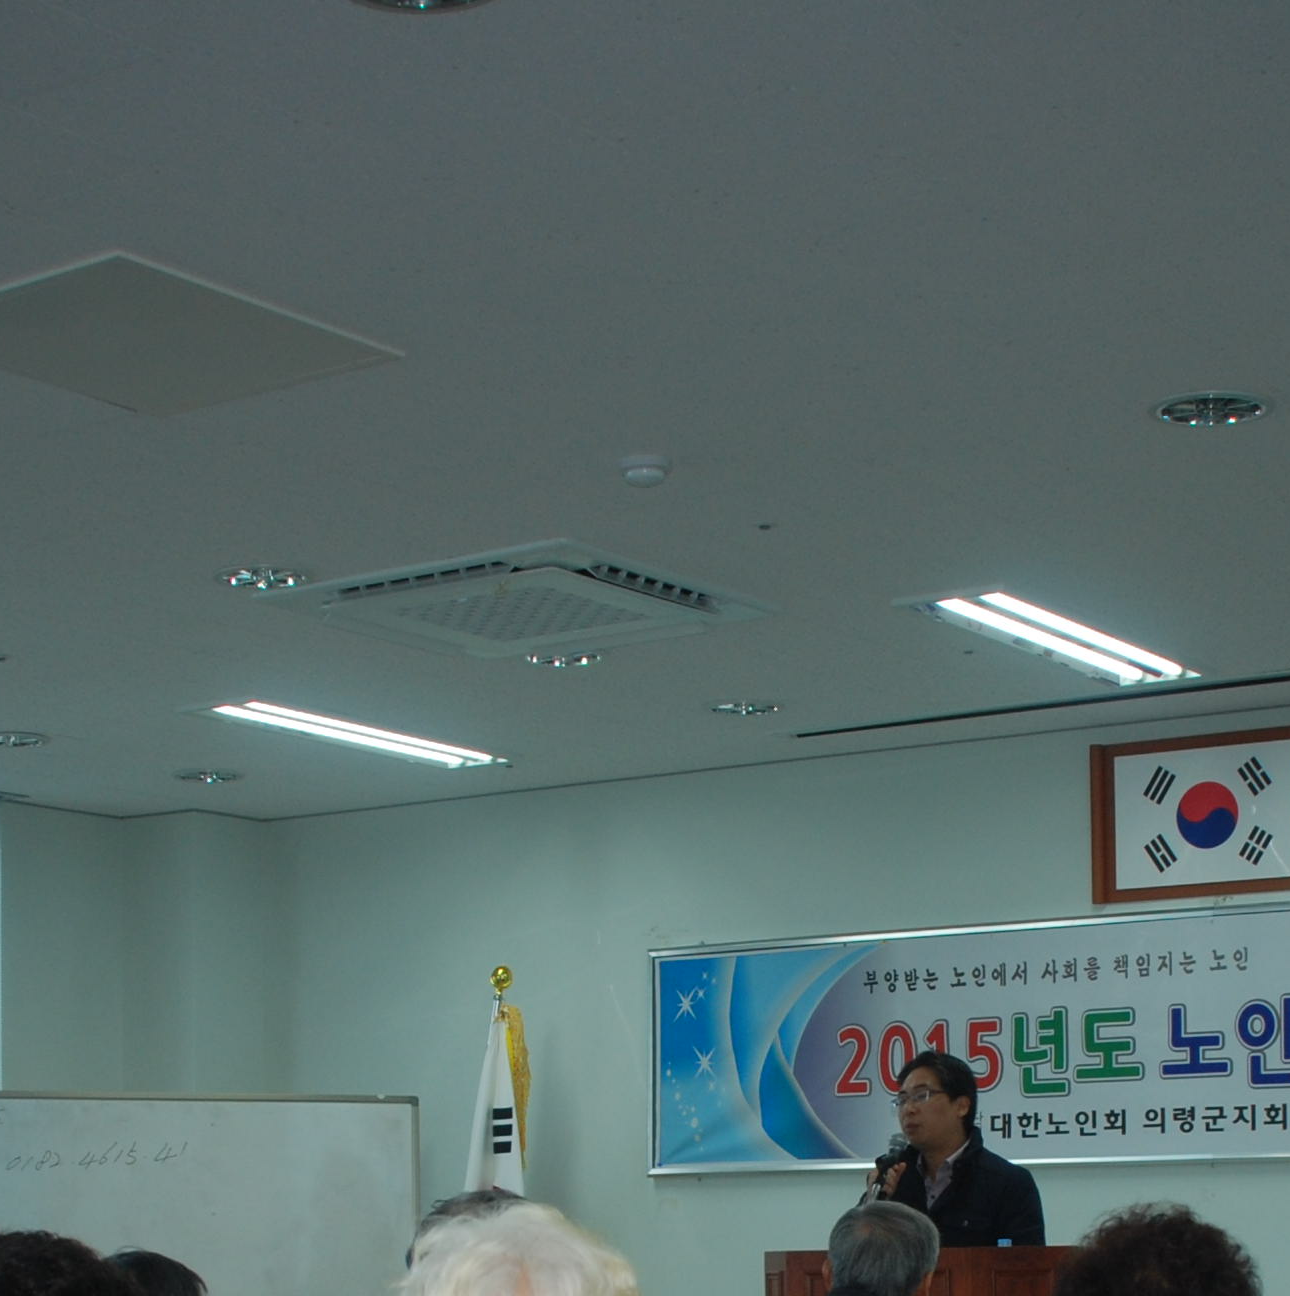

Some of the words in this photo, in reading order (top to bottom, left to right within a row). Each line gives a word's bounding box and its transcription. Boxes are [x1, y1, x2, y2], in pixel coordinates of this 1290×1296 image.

[863, 967, 939, 994] 부양받는
[949, 960, 1028, 988] 노인에서
[1040, 956, 1102, 984] 사회를
[1112, 950, 1197, 980] 책임지는
[1209, 945, 1250, 972] 노인
[989, 1108, 1127, 1139] 대한노인회
[1142, 1103, 1288, 1135] 의령군지회
